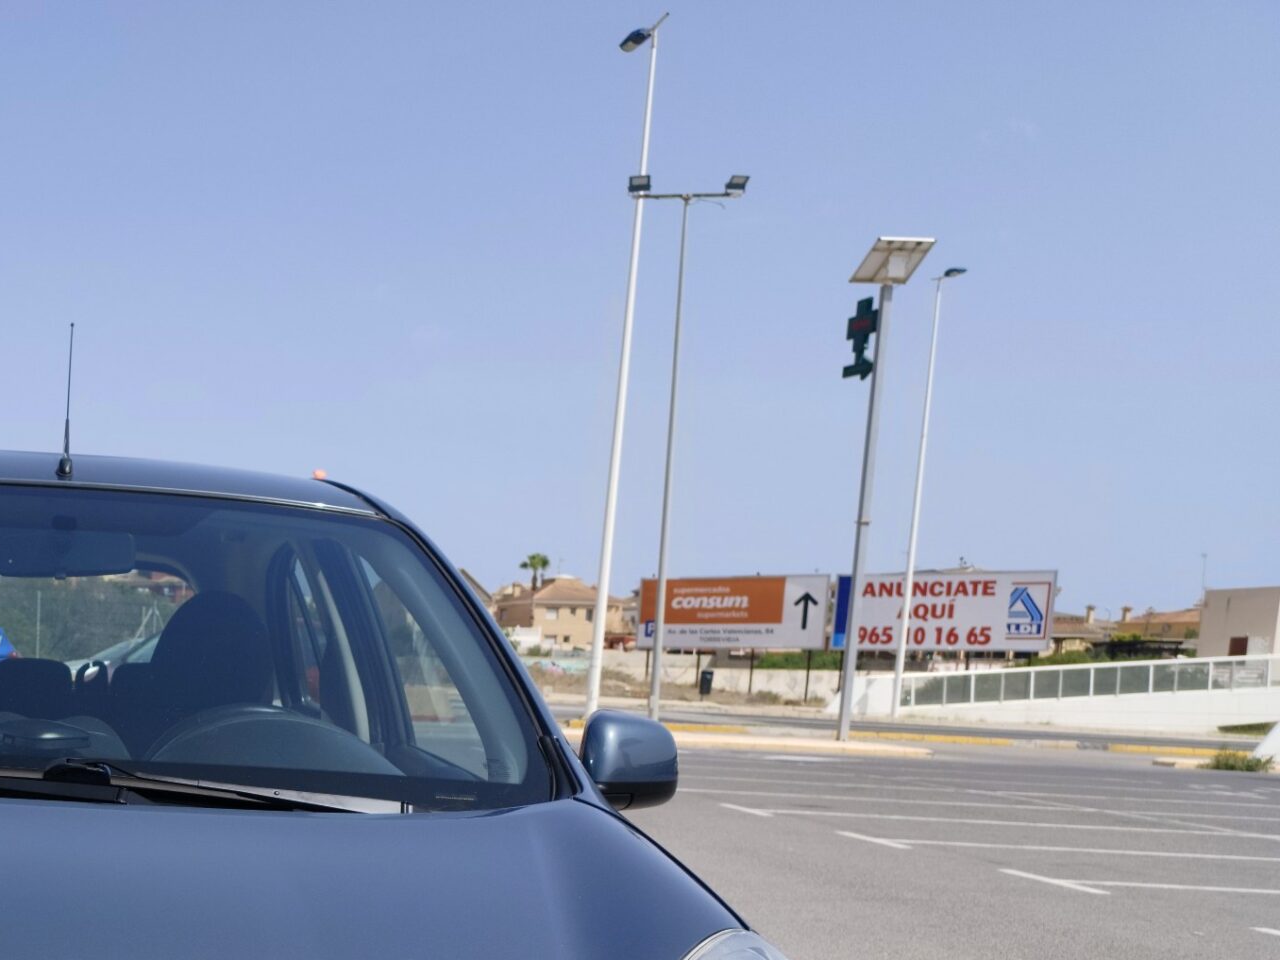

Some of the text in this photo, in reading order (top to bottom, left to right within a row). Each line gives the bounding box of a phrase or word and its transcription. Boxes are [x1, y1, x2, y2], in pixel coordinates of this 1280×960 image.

[670, 595, 749, 609] consum
[858, 626, 893, 645] 965
[935, 626, 959, 645] 16
[966, 626, 992, 645] 65
